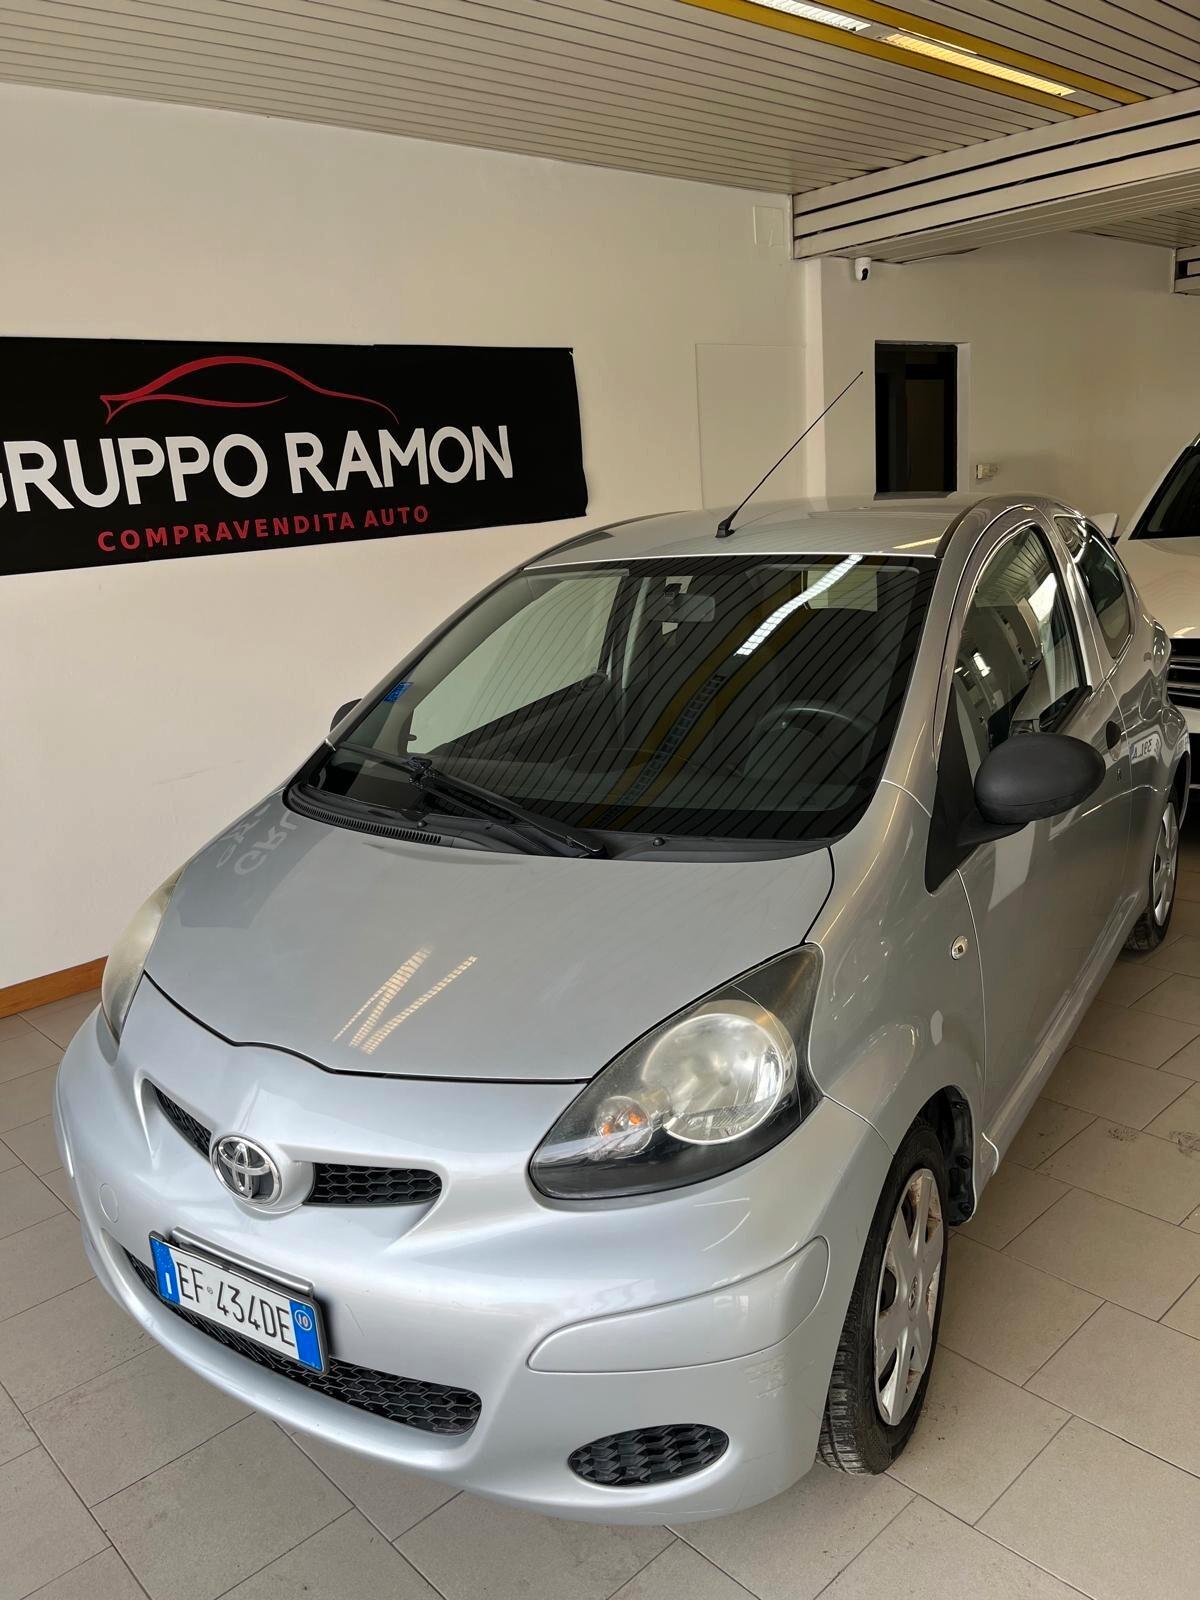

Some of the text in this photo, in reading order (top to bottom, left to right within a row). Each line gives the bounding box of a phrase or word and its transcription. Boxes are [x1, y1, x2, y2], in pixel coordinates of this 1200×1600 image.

[0, 426, 513, 512] RUPPO RAMON
[98, 506, 429, 552] COMPRAVENDITA AUTO
